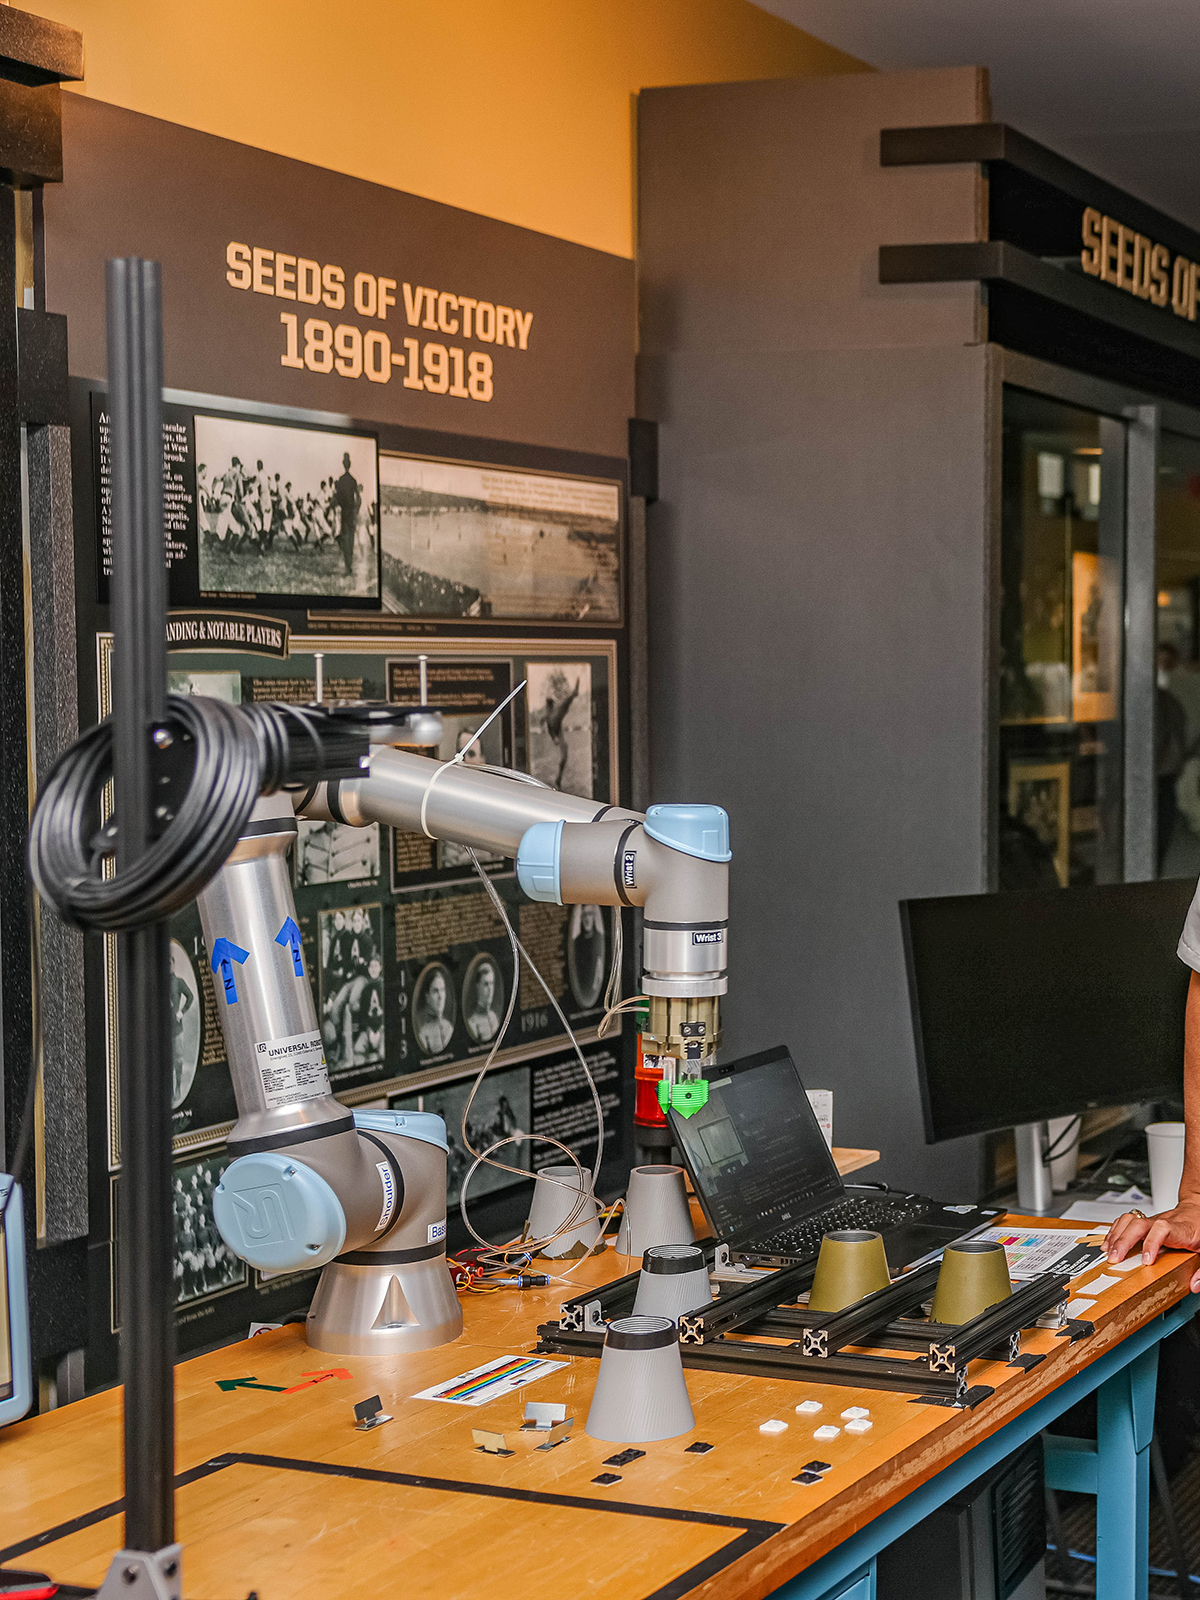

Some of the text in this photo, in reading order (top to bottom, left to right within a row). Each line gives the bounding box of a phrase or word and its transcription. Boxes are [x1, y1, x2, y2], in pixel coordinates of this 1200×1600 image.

[1081, 206, 1170, 308] SEEDS
[226, 241, 534, 350] SEEDS OF VICTORY
[280, 311, 494, 402] 1890-1918
[171, 442, 189, 453] West
[166, 621, 198, 642] ANDING
[199, 620, 206, 640] &
[207, 620, 246, 642] NOTABLE
[246, 623, 282, 649] PLAYERS
[625, 863, 634, 886] Wrist
[695, 933, 716, 943] Wrist
[521, 1012, 549, 1032] 1916
[268, 1042, 309, 1056] UNIVERSAL
[379, 1167, 393, 1226] Shoulder
